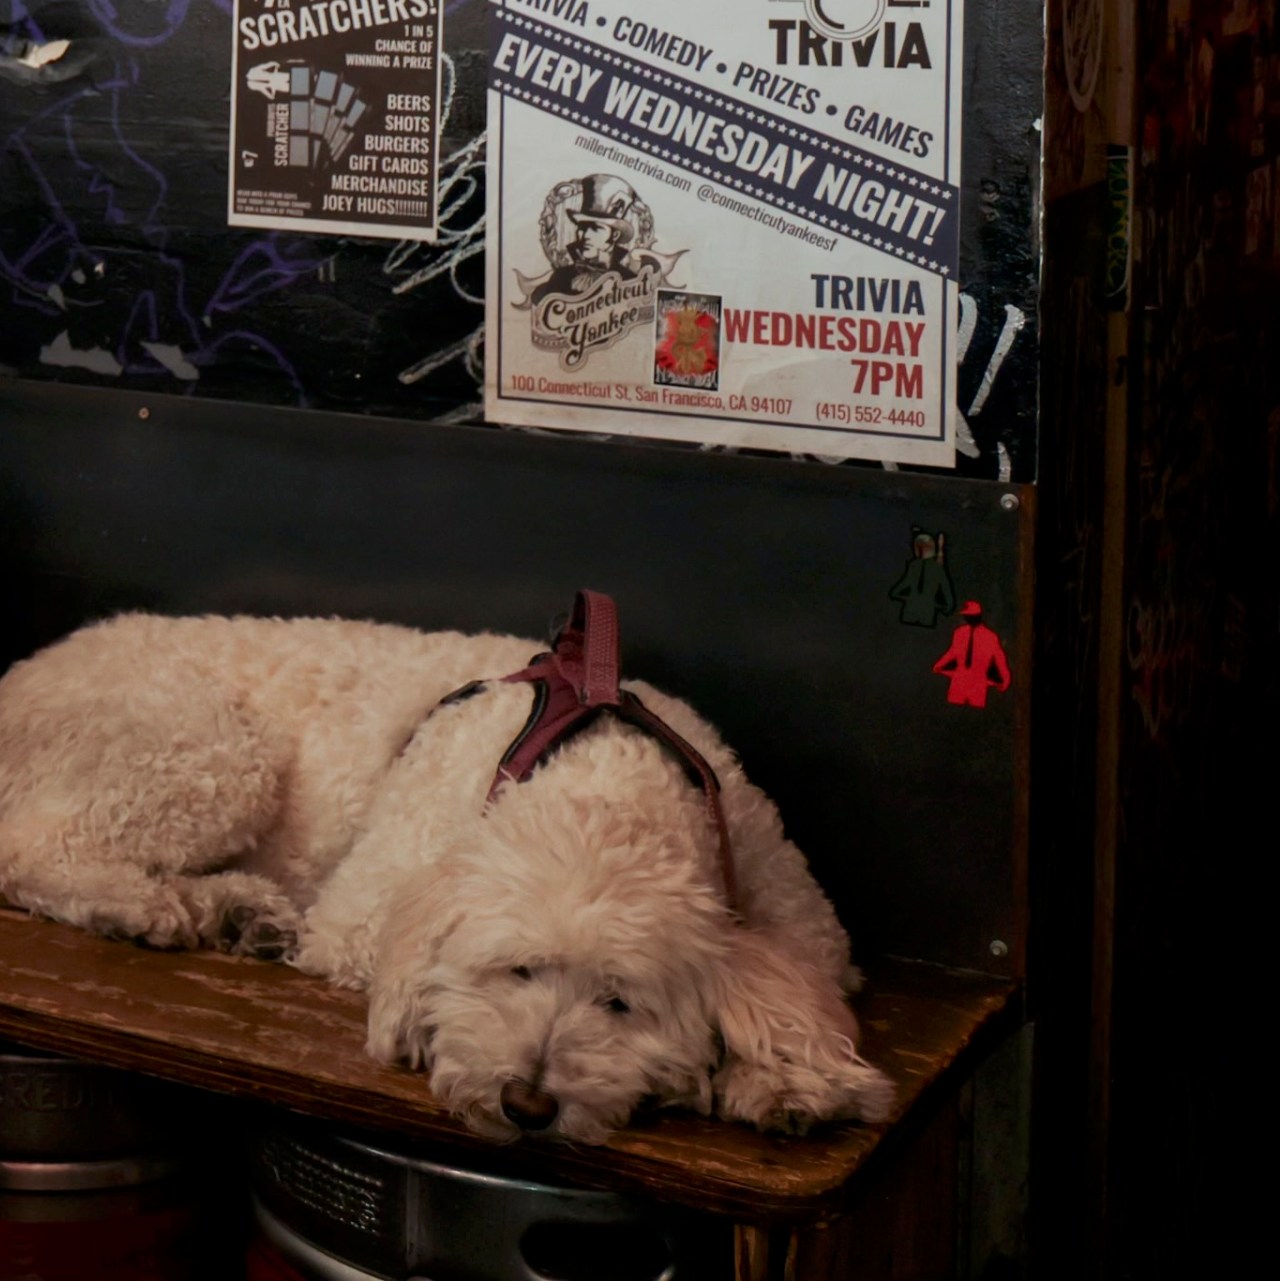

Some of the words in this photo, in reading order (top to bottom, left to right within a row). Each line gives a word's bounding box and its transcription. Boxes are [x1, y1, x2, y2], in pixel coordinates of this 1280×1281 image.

[375, 39, 417, 53] CHANCE
[419, 40, 434, 54] OF
[404, 24, 410, 37] 1
[412, 24, 424, 38] IN
[426, 25, 434, 38] 5
[769, 19, 932, 69] TRIVIA
[345, 53, 390, 68] WINNING
[392, 55, 400, 68] A
[402, 56, 433, 70] PRIZE
[387, 94, 431, 112] BEERS
[613, 15, 712, 73] COMEDY
[735, 61, 820, 115] PRIZES
[844, 104, 934, 160] GAMES
[274, 103, 289, 167] SCRATCHER
[385, 114, 430, 133] SHOTS
[494, 33, 602, 104] EVERY
[604, 74, 818, 197] WEDNESDAY
[815, 166, 947, 246] NIGHT!
[348, 154, 378, 172] GIFT
[381, 156, 428, 175] CARDS
[364, 134, 429, 155] BURGERS
[322, 194, 354, 212] JOEY
[331, 174, 428, 196] MERCHANDISE
[574, 134, 692, 192] millertimetrivia.com
[696, 183, 838, 253] @connecticutyankeesf
[542, 272, 651, 333] Connecticut
[811, 274, 926, 316] TRIVIA
[564, 307, 638, 367] Yankee
[724, 307, 925, 358] WEDNESDAY
[511, 375, 535, 392] 100
[538, 377, 611, 399] Connecticut
[635, 386, 658, 403] San
[662, 388, 725, 412] Francisco,
[729, 394, 747, 411] CA
[751, 396, 792, 415] 94107
[850, 359, 924, 400] 7PM
[815, 402, 851, 424] (415)
[854, 405, 925, 428] 552-4440
